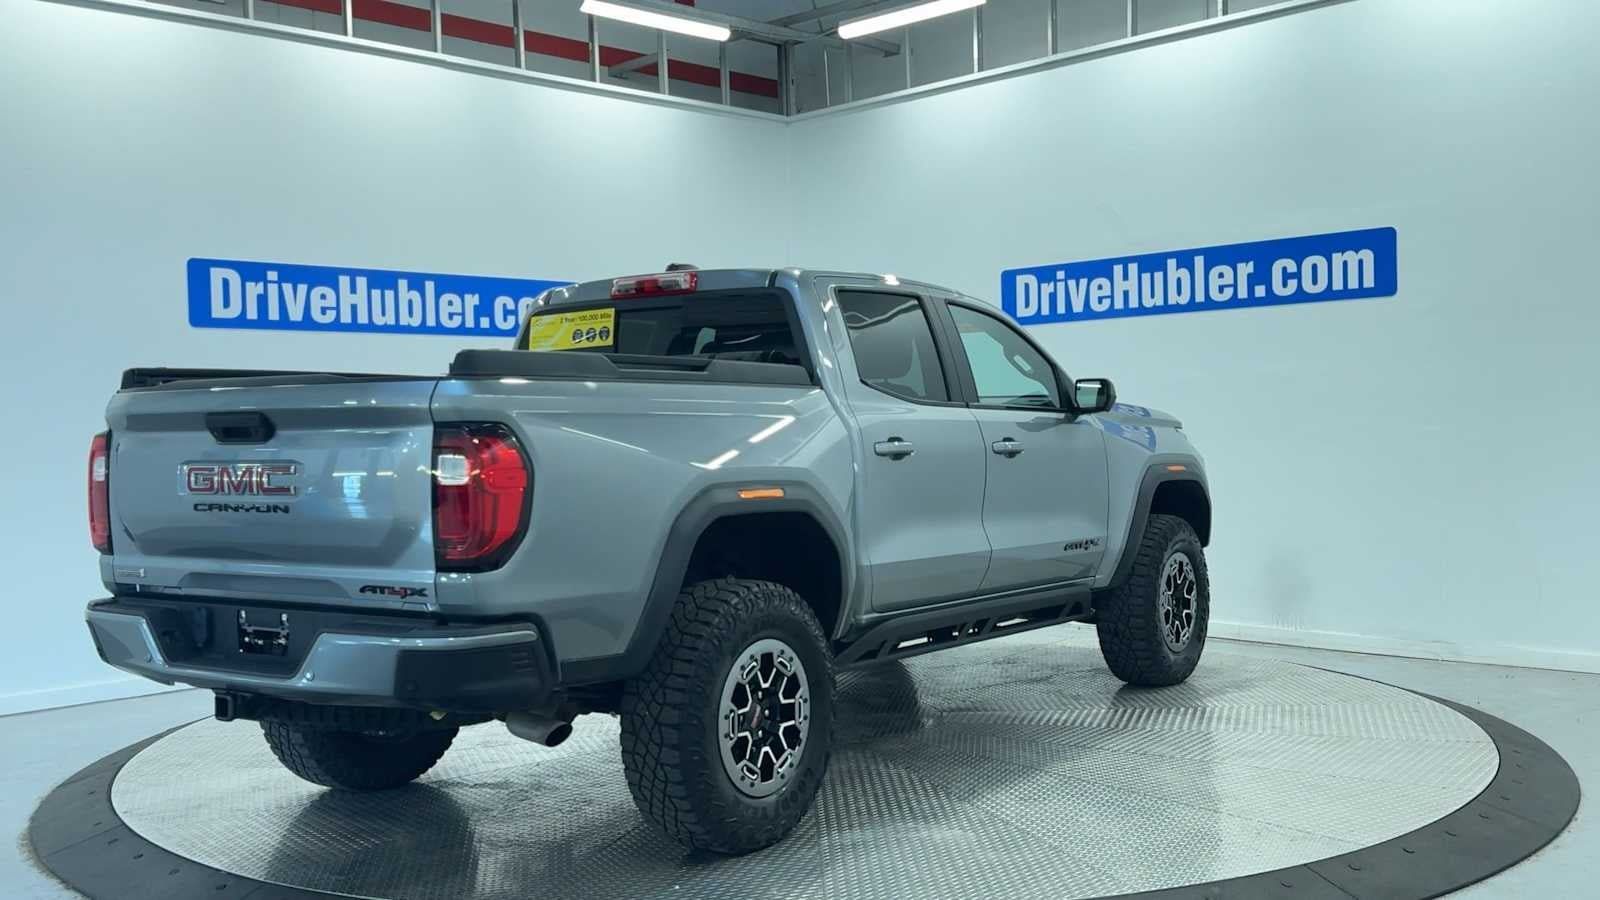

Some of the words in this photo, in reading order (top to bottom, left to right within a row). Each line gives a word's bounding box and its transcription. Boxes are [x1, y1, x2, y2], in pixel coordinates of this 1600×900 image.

[1015, 248, 1375, 318] DriveHubler.com
[186, 464, 297, 496] GMC
[193, 502, 290, 515] CANYON
[359, 584, 429, 599] AT4X
